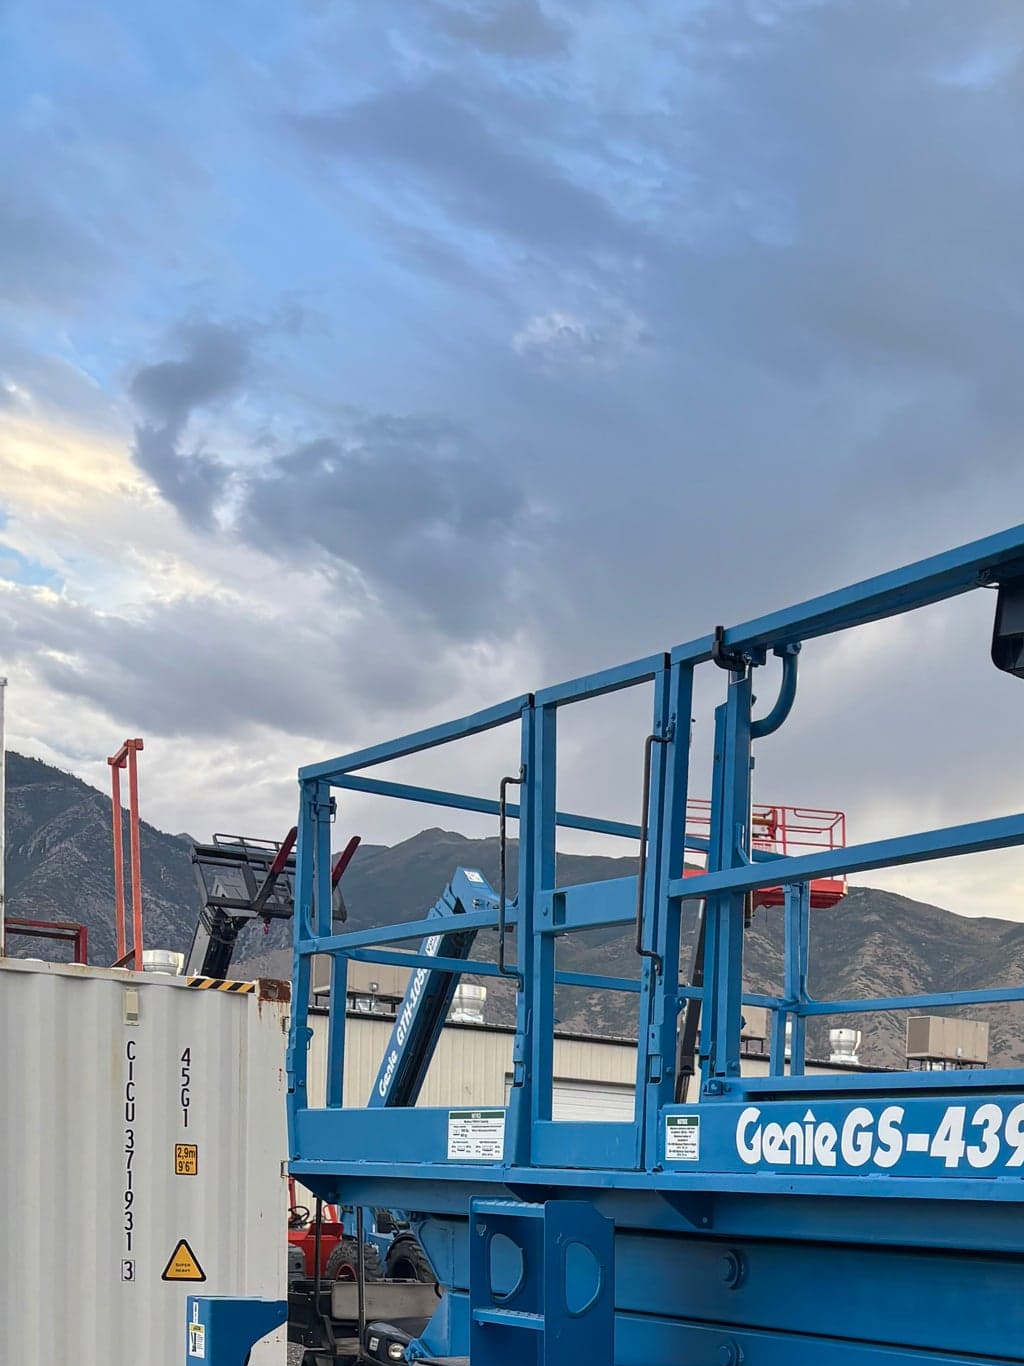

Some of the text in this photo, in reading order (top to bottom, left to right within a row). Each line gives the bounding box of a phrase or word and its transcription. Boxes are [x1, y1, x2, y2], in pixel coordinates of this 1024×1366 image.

[379, 967, 428, 1097] Genie GTH-105
[181, 1048, 191, 1127] 45G1
[124, 1041, 136, 1280] CICU 371931 3
[177, 1147, 195, 1159] 2,9m
